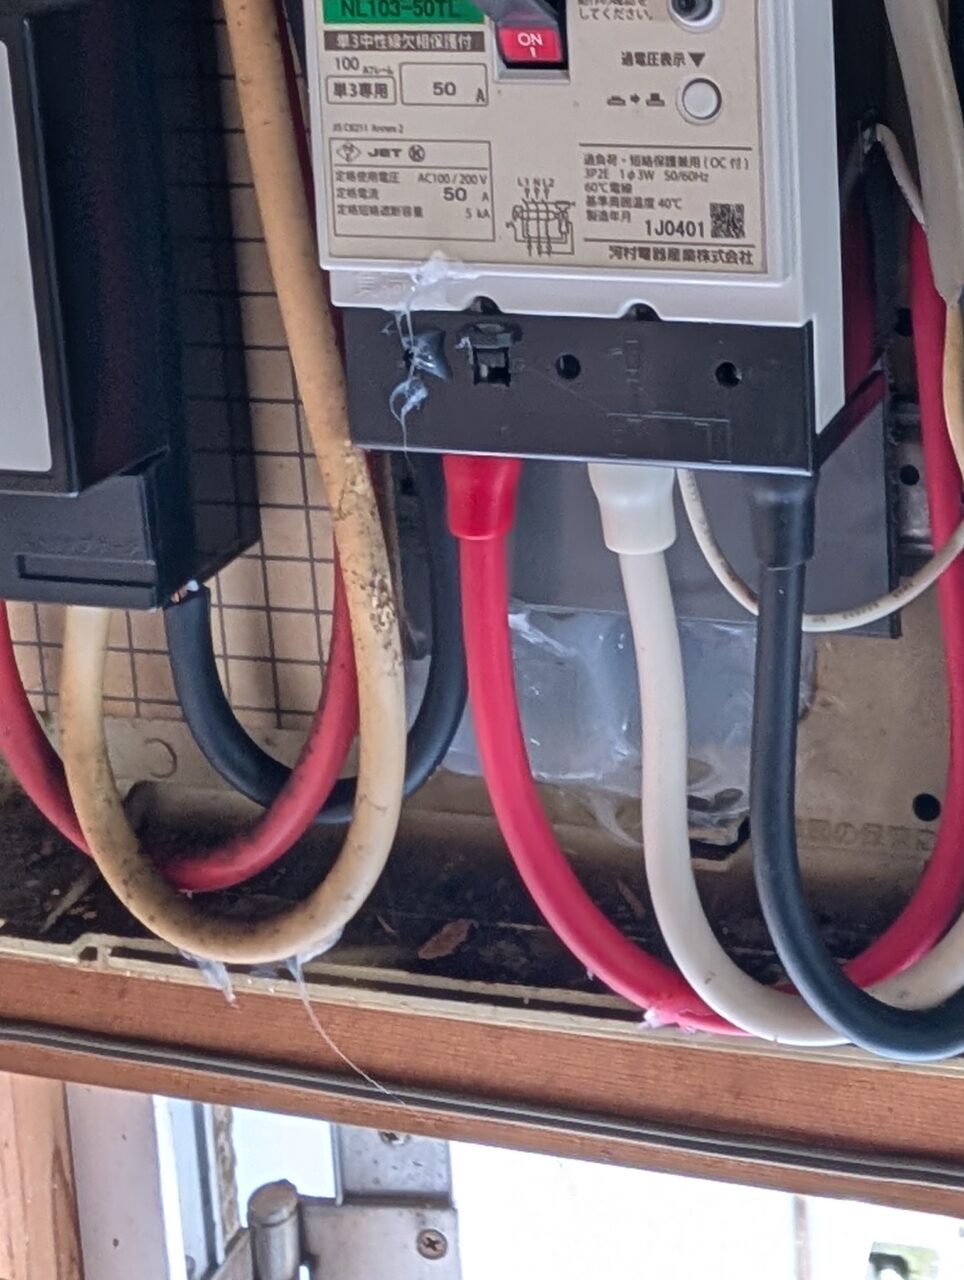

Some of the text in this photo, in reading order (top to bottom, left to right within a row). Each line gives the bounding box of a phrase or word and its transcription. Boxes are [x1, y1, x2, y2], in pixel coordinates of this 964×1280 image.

[578, 8, 656, 21] してください。
[517, 33, 543, 47] ON
[335, 56, 360, 71] 100
[432, 81, 486, 103] 50 A
[443, 187, 468, 202] 50
[644, 219, 705, 239] 1J0401
